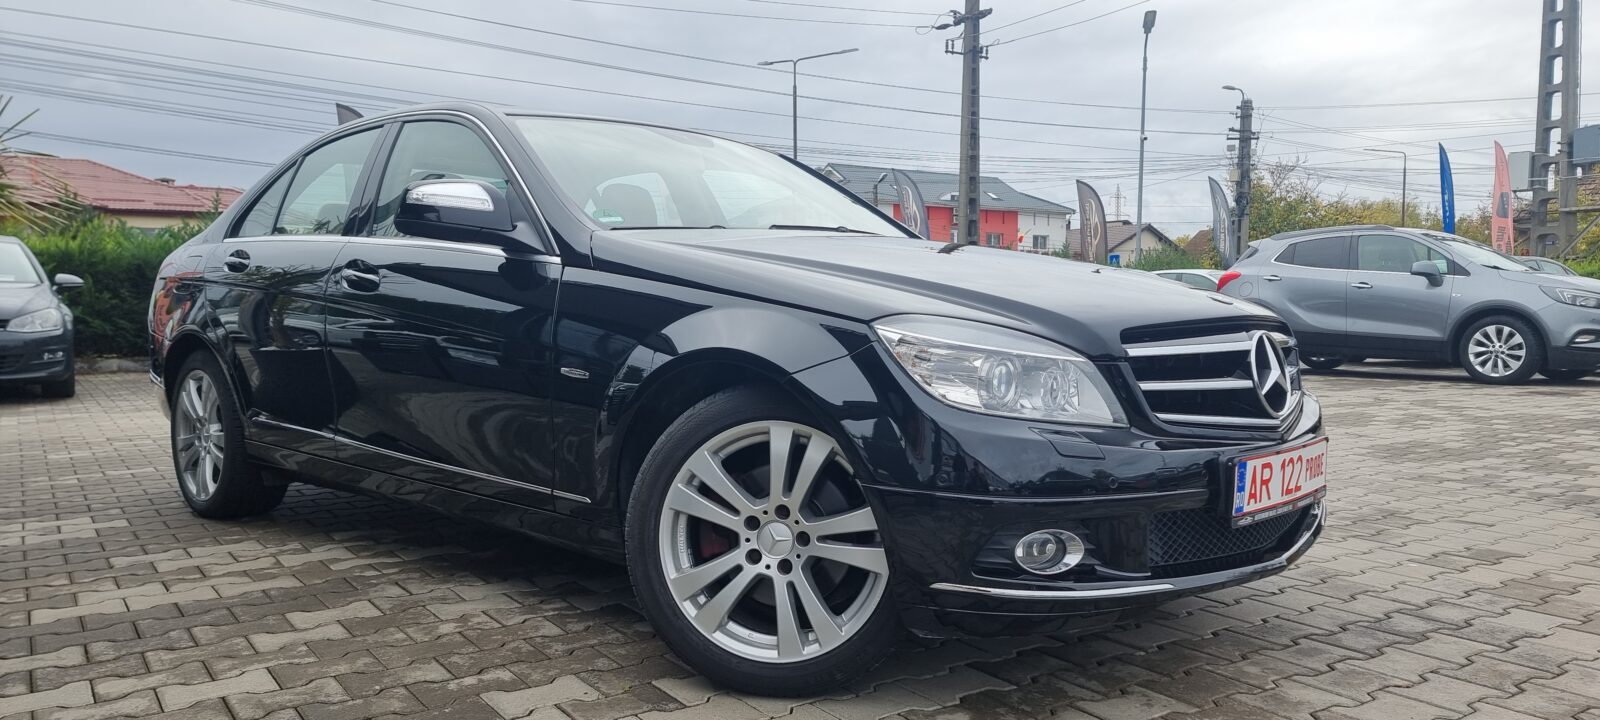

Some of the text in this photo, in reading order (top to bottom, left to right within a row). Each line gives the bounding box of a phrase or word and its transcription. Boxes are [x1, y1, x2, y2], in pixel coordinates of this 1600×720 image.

[1247, 453, 1324, 506] AR 122 PROBE
[1236, 492, 1245, 509] RO
